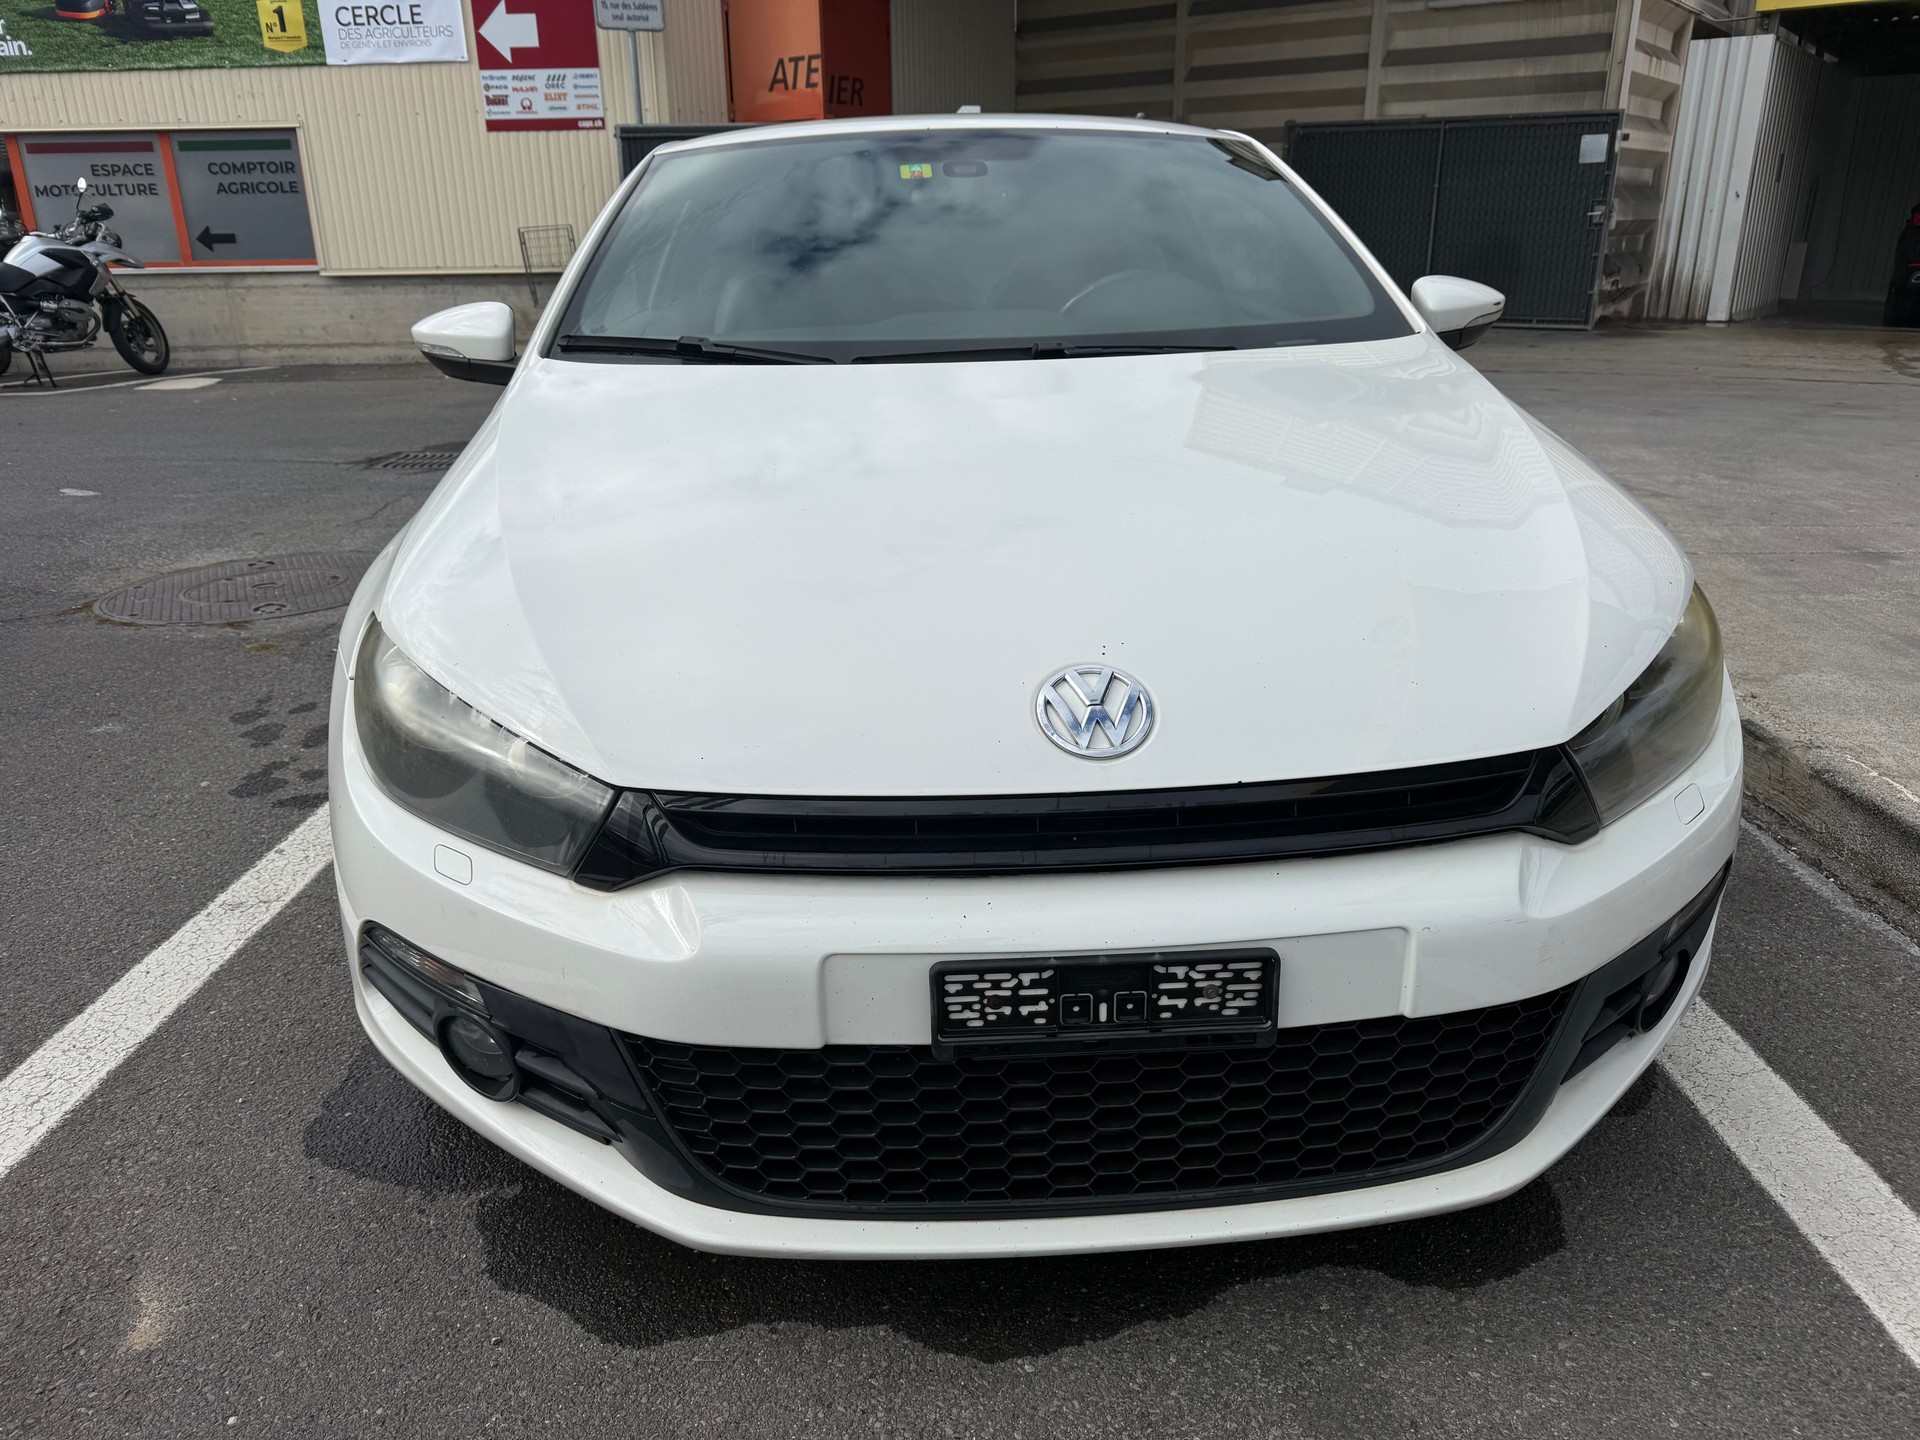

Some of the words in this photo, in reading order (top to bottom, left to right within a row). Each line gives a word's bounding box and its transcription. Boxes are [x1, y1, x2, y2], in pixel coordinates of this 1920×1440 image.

[621, 2, 631, 10] des
[272, 5, 287, 33] 1
[335, 4, 424, 27] CERCLE
[338, 27, 362, 40] DES
[365, 25, 453, 39] AGRICULTEURS
[340, 41, 351, 49] DE
[383, 40, 392, 48] ET
[393, 38, 432, 48] ENVIRONS
[90, 163, 155, 177] ESPACE
[207, 161, 296, 175] COMPTOIR
[216, 181, 300, 195] AGRICOLE
